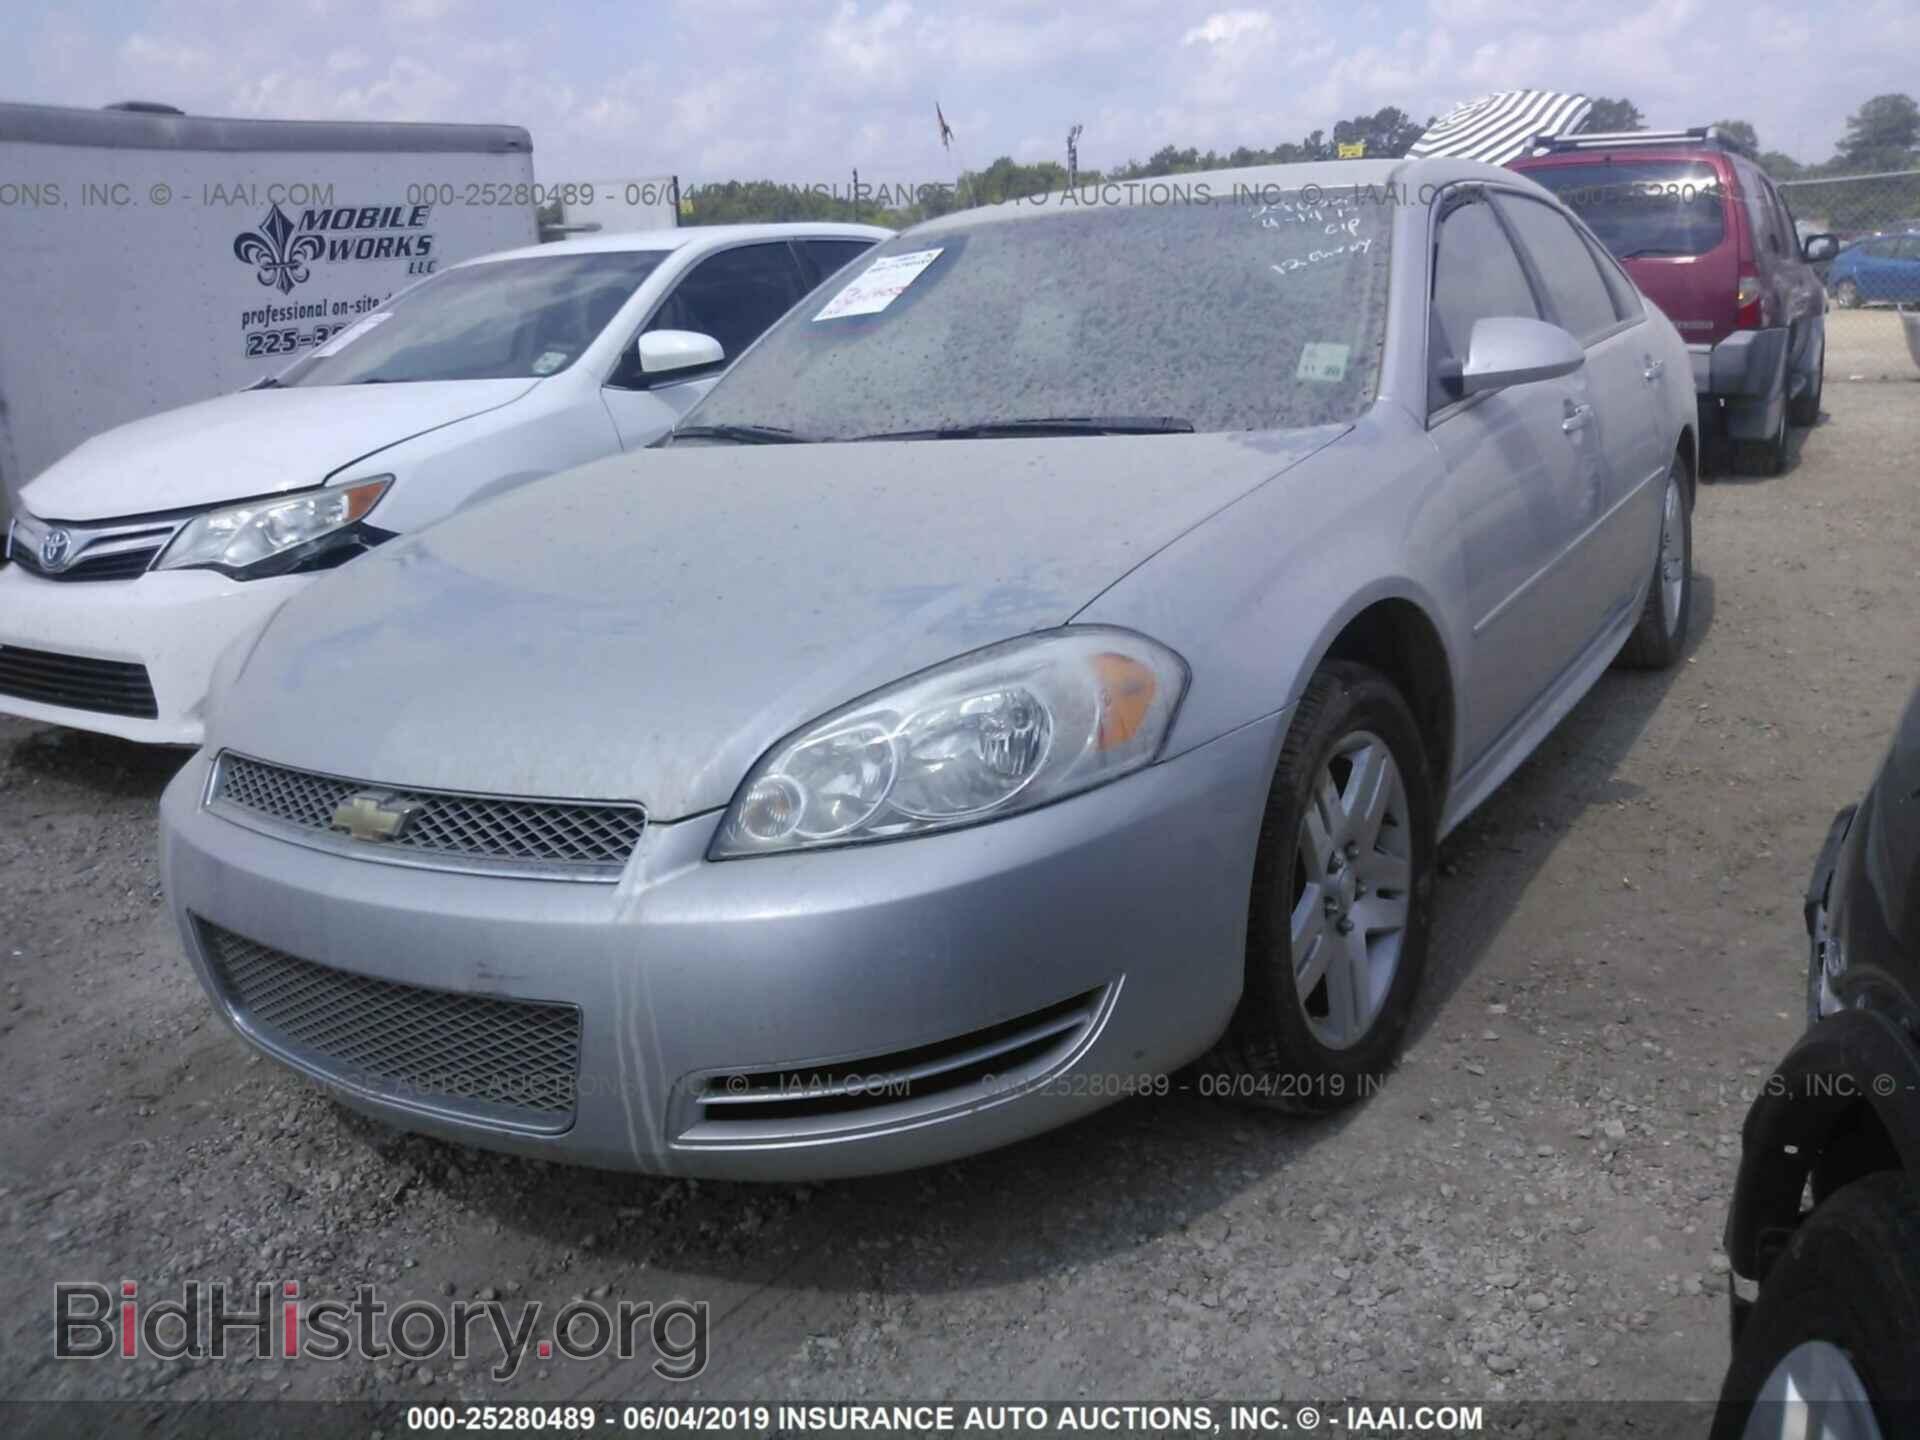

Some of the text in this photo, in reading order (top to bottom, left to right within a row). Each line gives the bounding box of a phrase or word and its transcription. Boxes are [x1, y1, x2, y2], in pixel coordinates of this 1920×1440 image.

[298, 204, 430, 233] MOBILE
[328, 235, 433, 262] WORKS
[408, 261, 437, 275] LLC
[241, 299, 328, 330] professional
